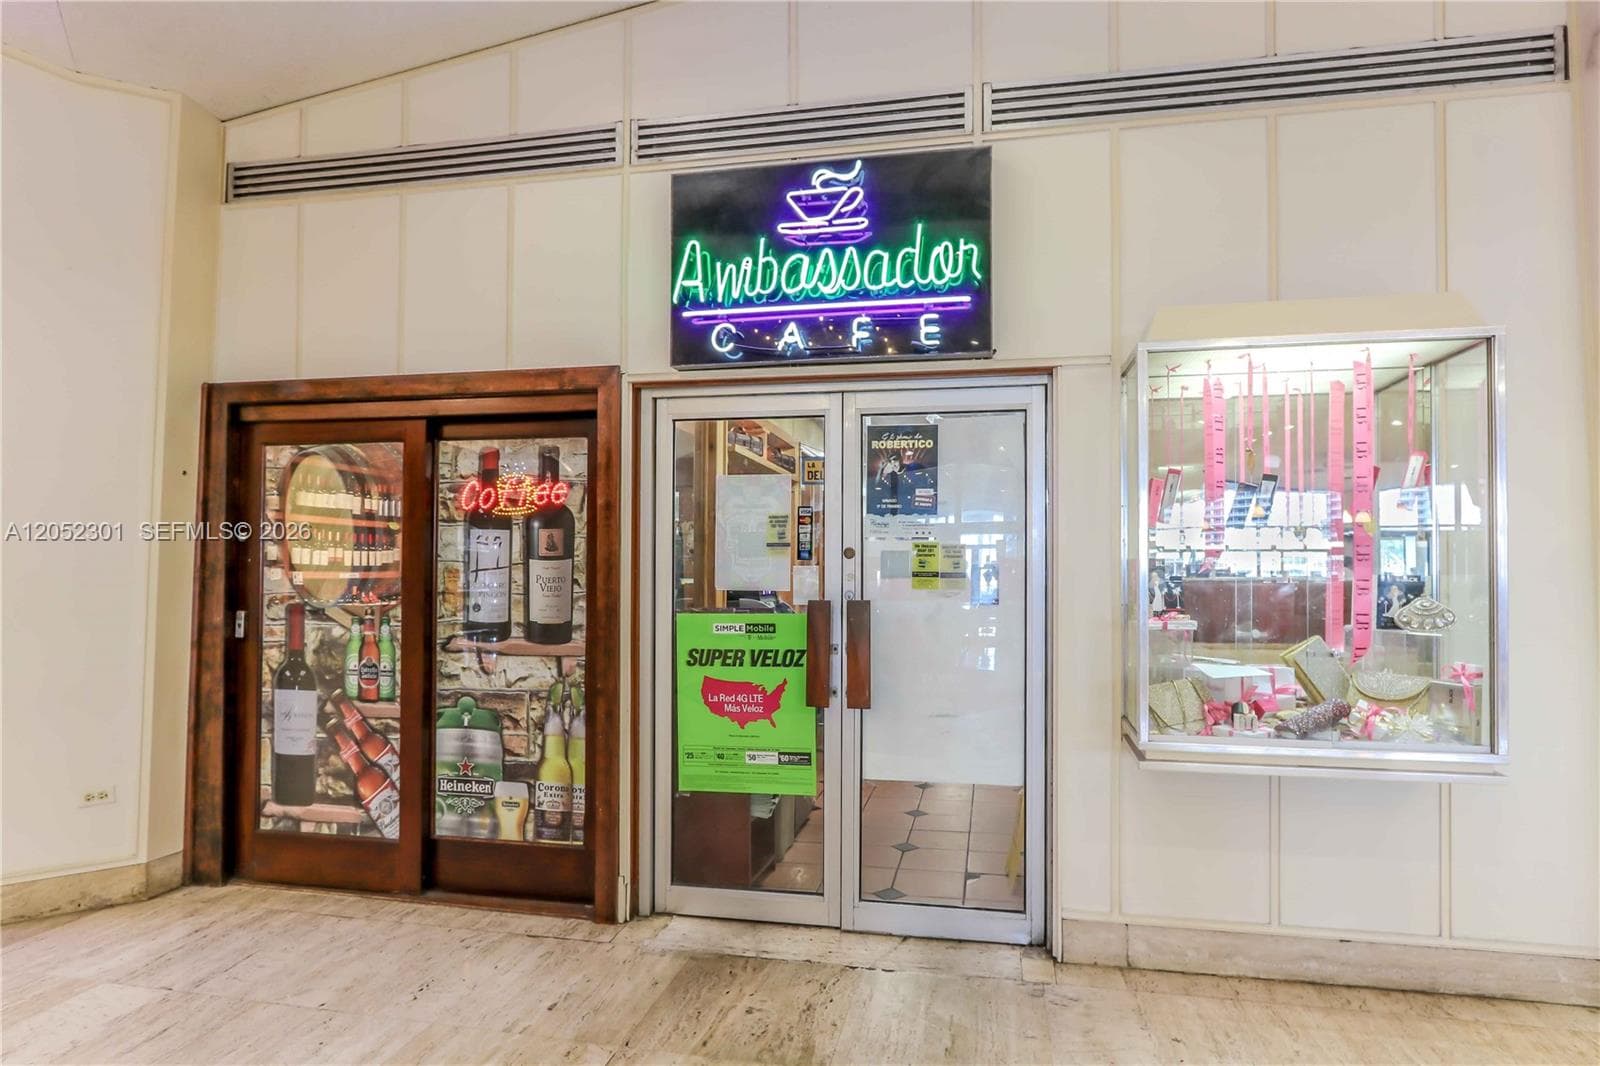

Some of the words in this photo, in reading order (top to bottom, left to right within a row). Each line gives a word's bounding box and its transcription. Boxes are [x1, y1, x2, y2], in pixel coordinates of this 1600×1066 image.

[672, 223, 982, 304] Ambassador
[711, 314, 940, 352] CAFE
[871, 440, 934, 449] ROBERTICO
[714, 624, 744, 633] SIMPLE
[746, 624, 775, 633] Mobile
[686, 648, 746, 667] SUPER
[750, 649, 807, 668] VELOZ
[708, 693, 719, 703] La
[719, 693, 736, 703] Red
[736, 694, 748, 703] 4G
[749, 694, 764, 703] LTE
[724, 703, 741, 713] Más
[742, 704, 764, 713] Veloz
[439, 779, 492, 794] Heineken
